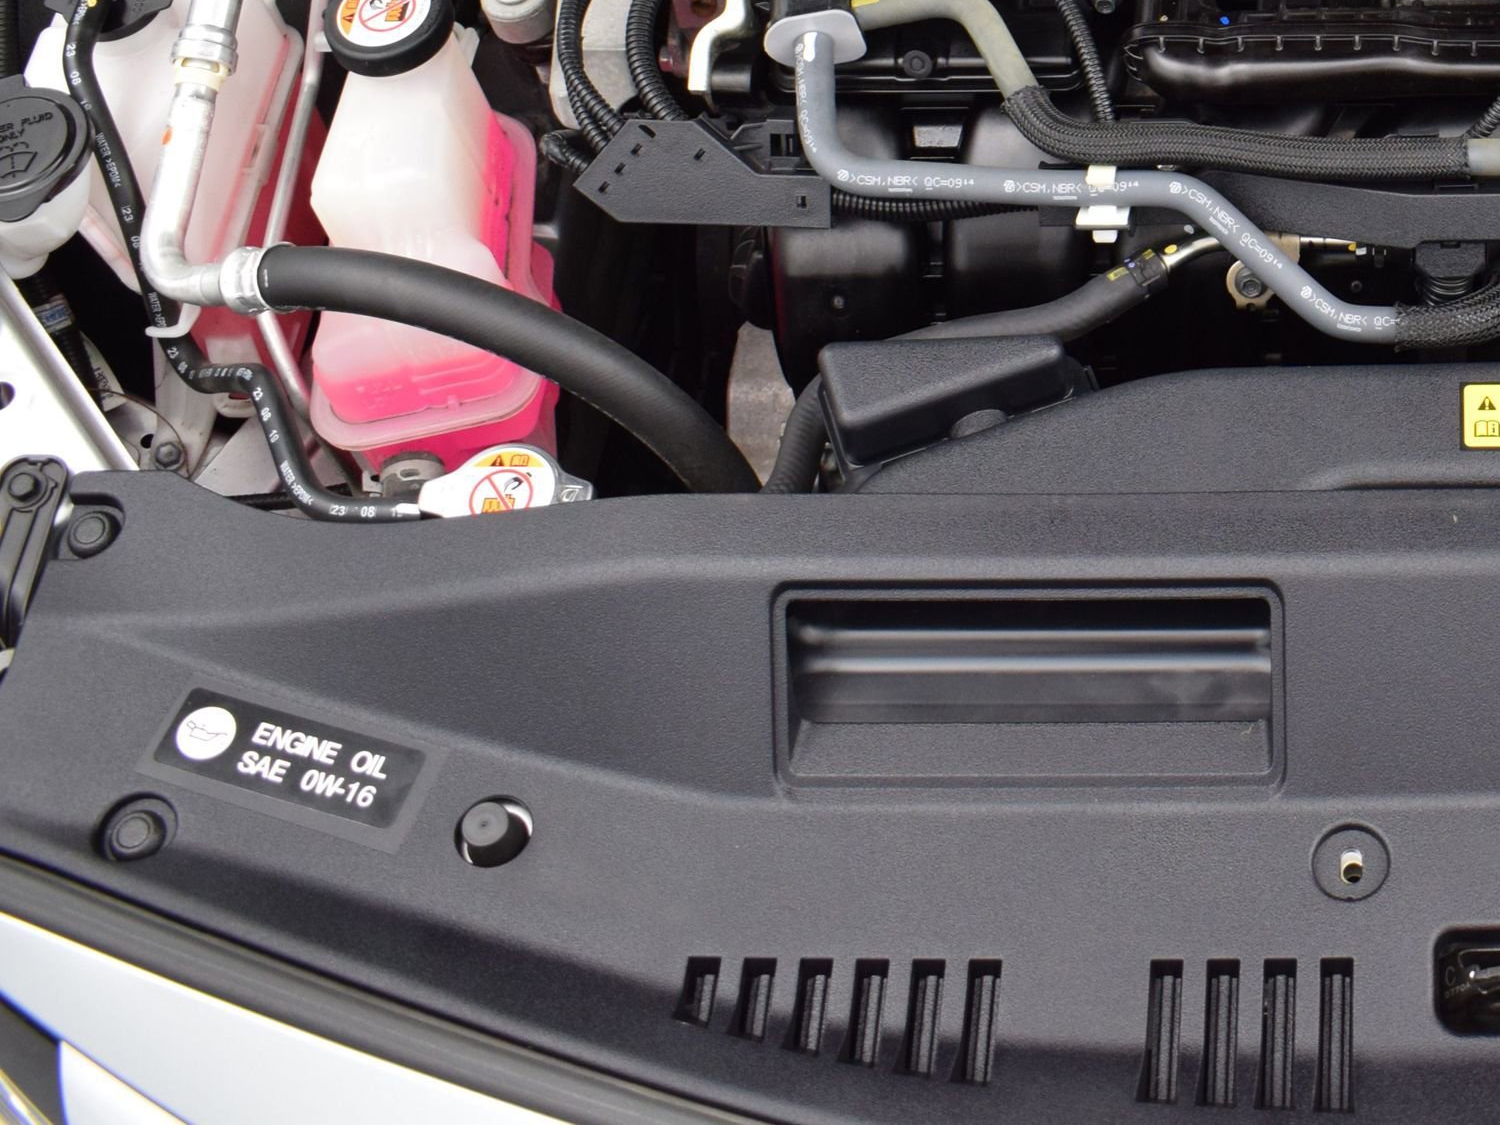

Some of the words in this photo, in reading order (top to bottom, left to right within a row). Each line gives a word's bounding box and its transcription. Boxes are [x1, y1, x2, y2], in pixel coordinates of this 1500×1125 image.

[96, 132, 113, 159] WATER
[121, 205, 135, 222] 23
[148, 291, 163, 315] WATER
[252, 387, 264, 401] 23
[260, 407, 272, 422] 08
[280, 460, 297, 486] WATER
[331, 505, 346, 516] 23
[360, 506, 375, 518] 08
[236, 750, 291, 783] SAE
[299, 769, 377, 808] 0W-16
[251, 721, 342, 765] ENGINE
[350, 750, 387, 780] OIL
